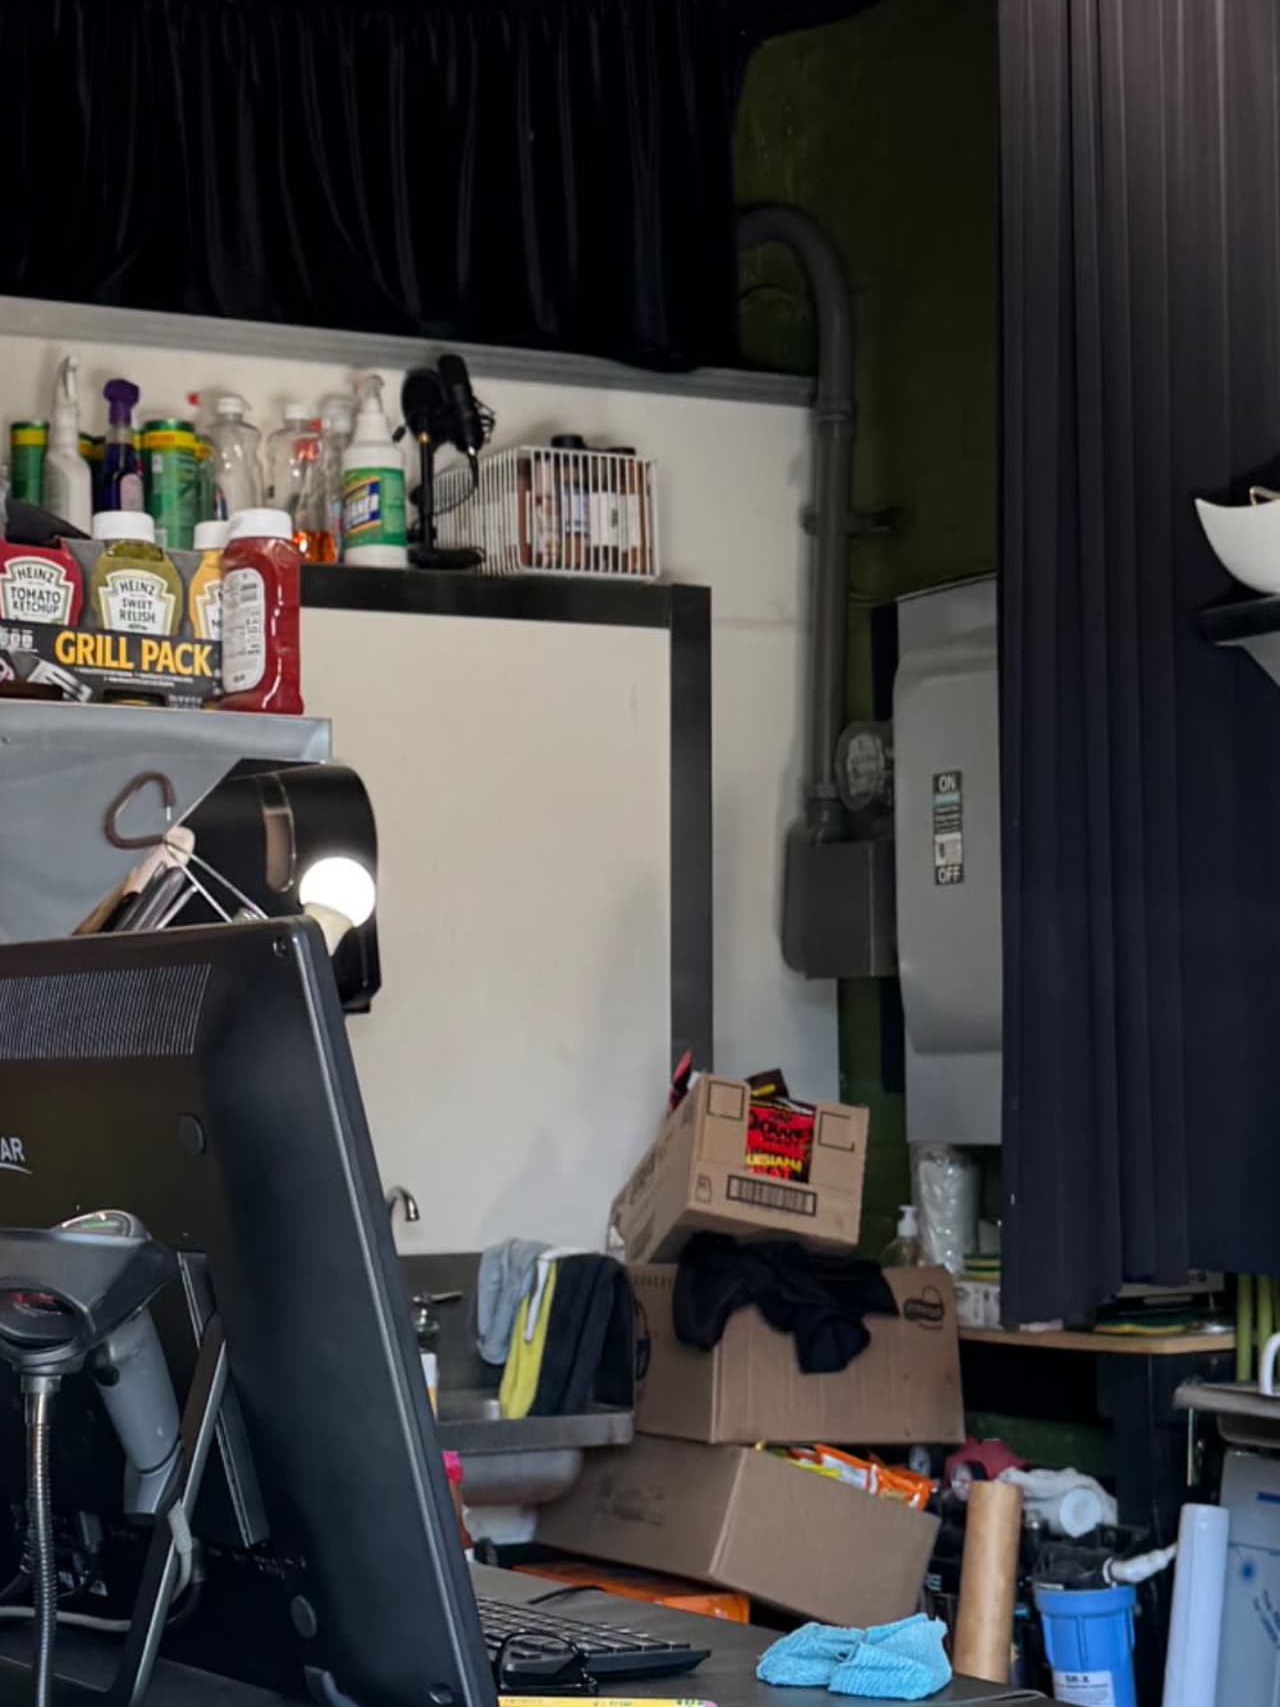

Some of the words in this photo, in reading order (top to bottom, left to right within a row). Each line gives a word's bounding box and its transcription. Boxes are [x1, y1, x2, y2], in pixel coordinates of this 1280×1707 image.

[17, 566, 55, 584] HEINZ
[10, 586, 62, 604] TOMATO
[119, 580, 156, 596] HEINZ
[12, 599, 60, 615] KETCHUP
[122, 597, 154, 611] SWEET
[119, 607, 156, 623] RELISH
[54, 630, 135, 670] GRILL
[140, 637, 214, 679] PACK
[938, 775, 957, 792] ON
[937, 868, 961, 884] OFF
